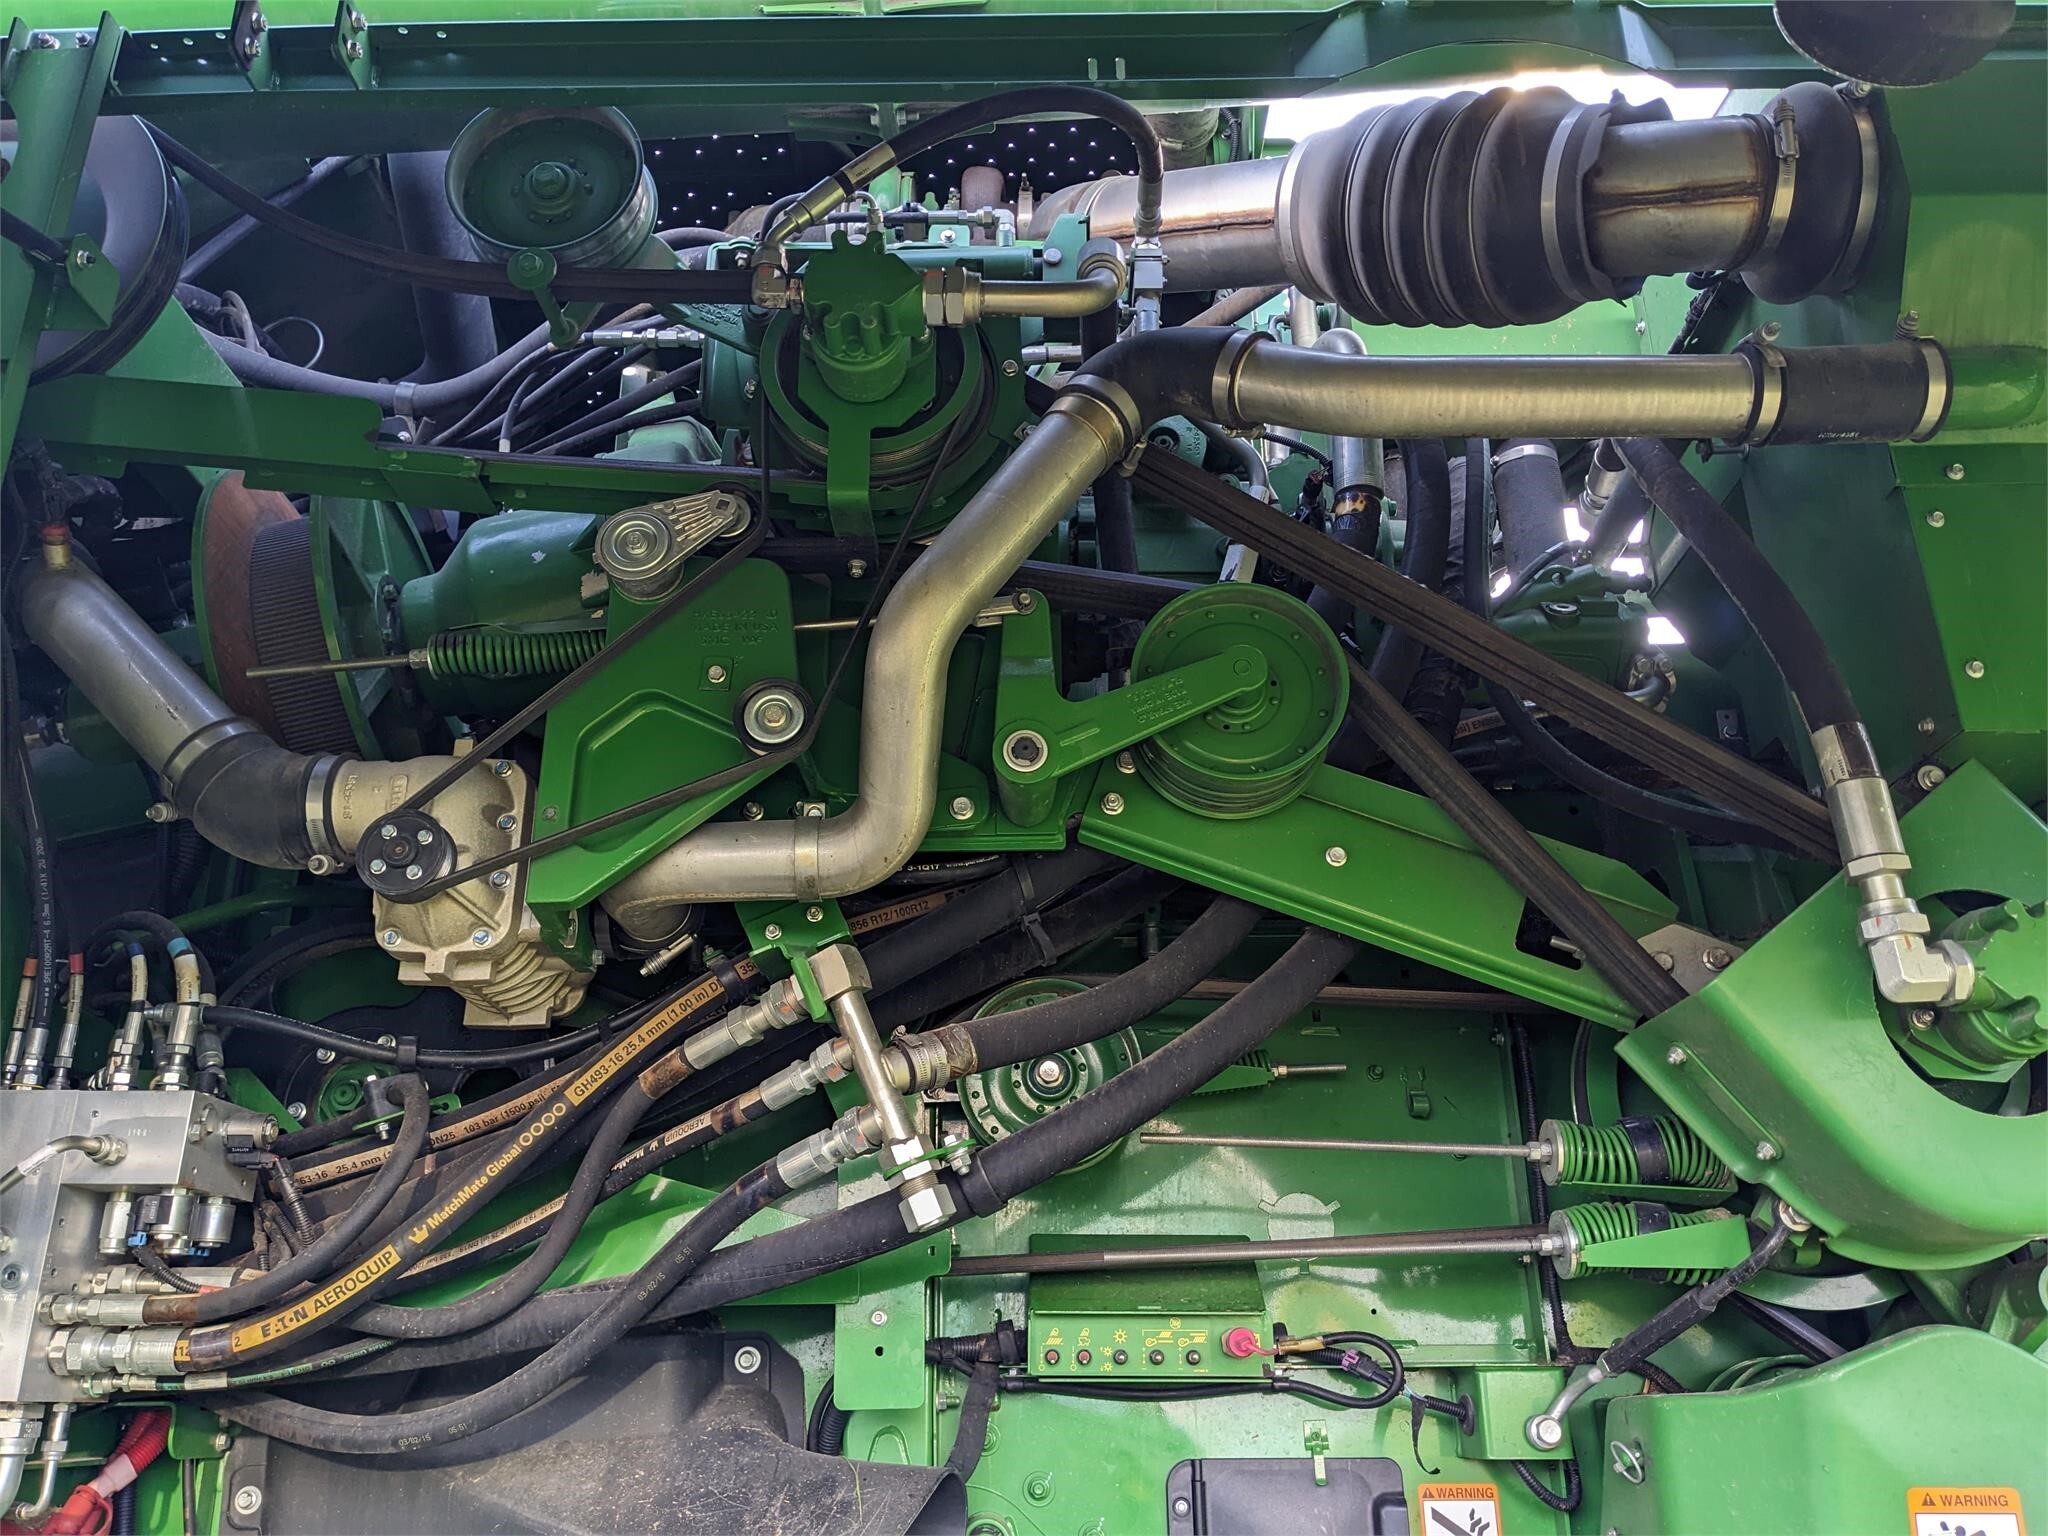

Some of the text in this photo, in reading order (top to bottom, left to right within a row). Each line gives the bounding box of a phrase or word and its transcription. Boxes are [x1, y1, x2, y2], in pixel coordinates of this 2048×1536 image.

[313, 1250, 394, 1314] AEROQUIP
[426, 1175, 489, 1229] MatchMate
[486, 1144, 522, 1177] Global
[573, 1052, 624, 1098] GH493-16
[622, 1034, 646, 1057] 25.4
[645, 1019, 669, 1039] mm
[666, 998, 693, 1022] (1.00
[694, 986, 710, 1004] in)
[335, 1160, 358, 1174] 25.4
[360, 1156, 381, 1167] mm
[463, 1122, 482, 1135] 103
[483, 1116, 499, 1128] bar
[500, 1102, 526, 1122] (1500
[1436, 1487, 1494, 1499] WARNING
[1939, 1494, 2009, 1507] WARNING
